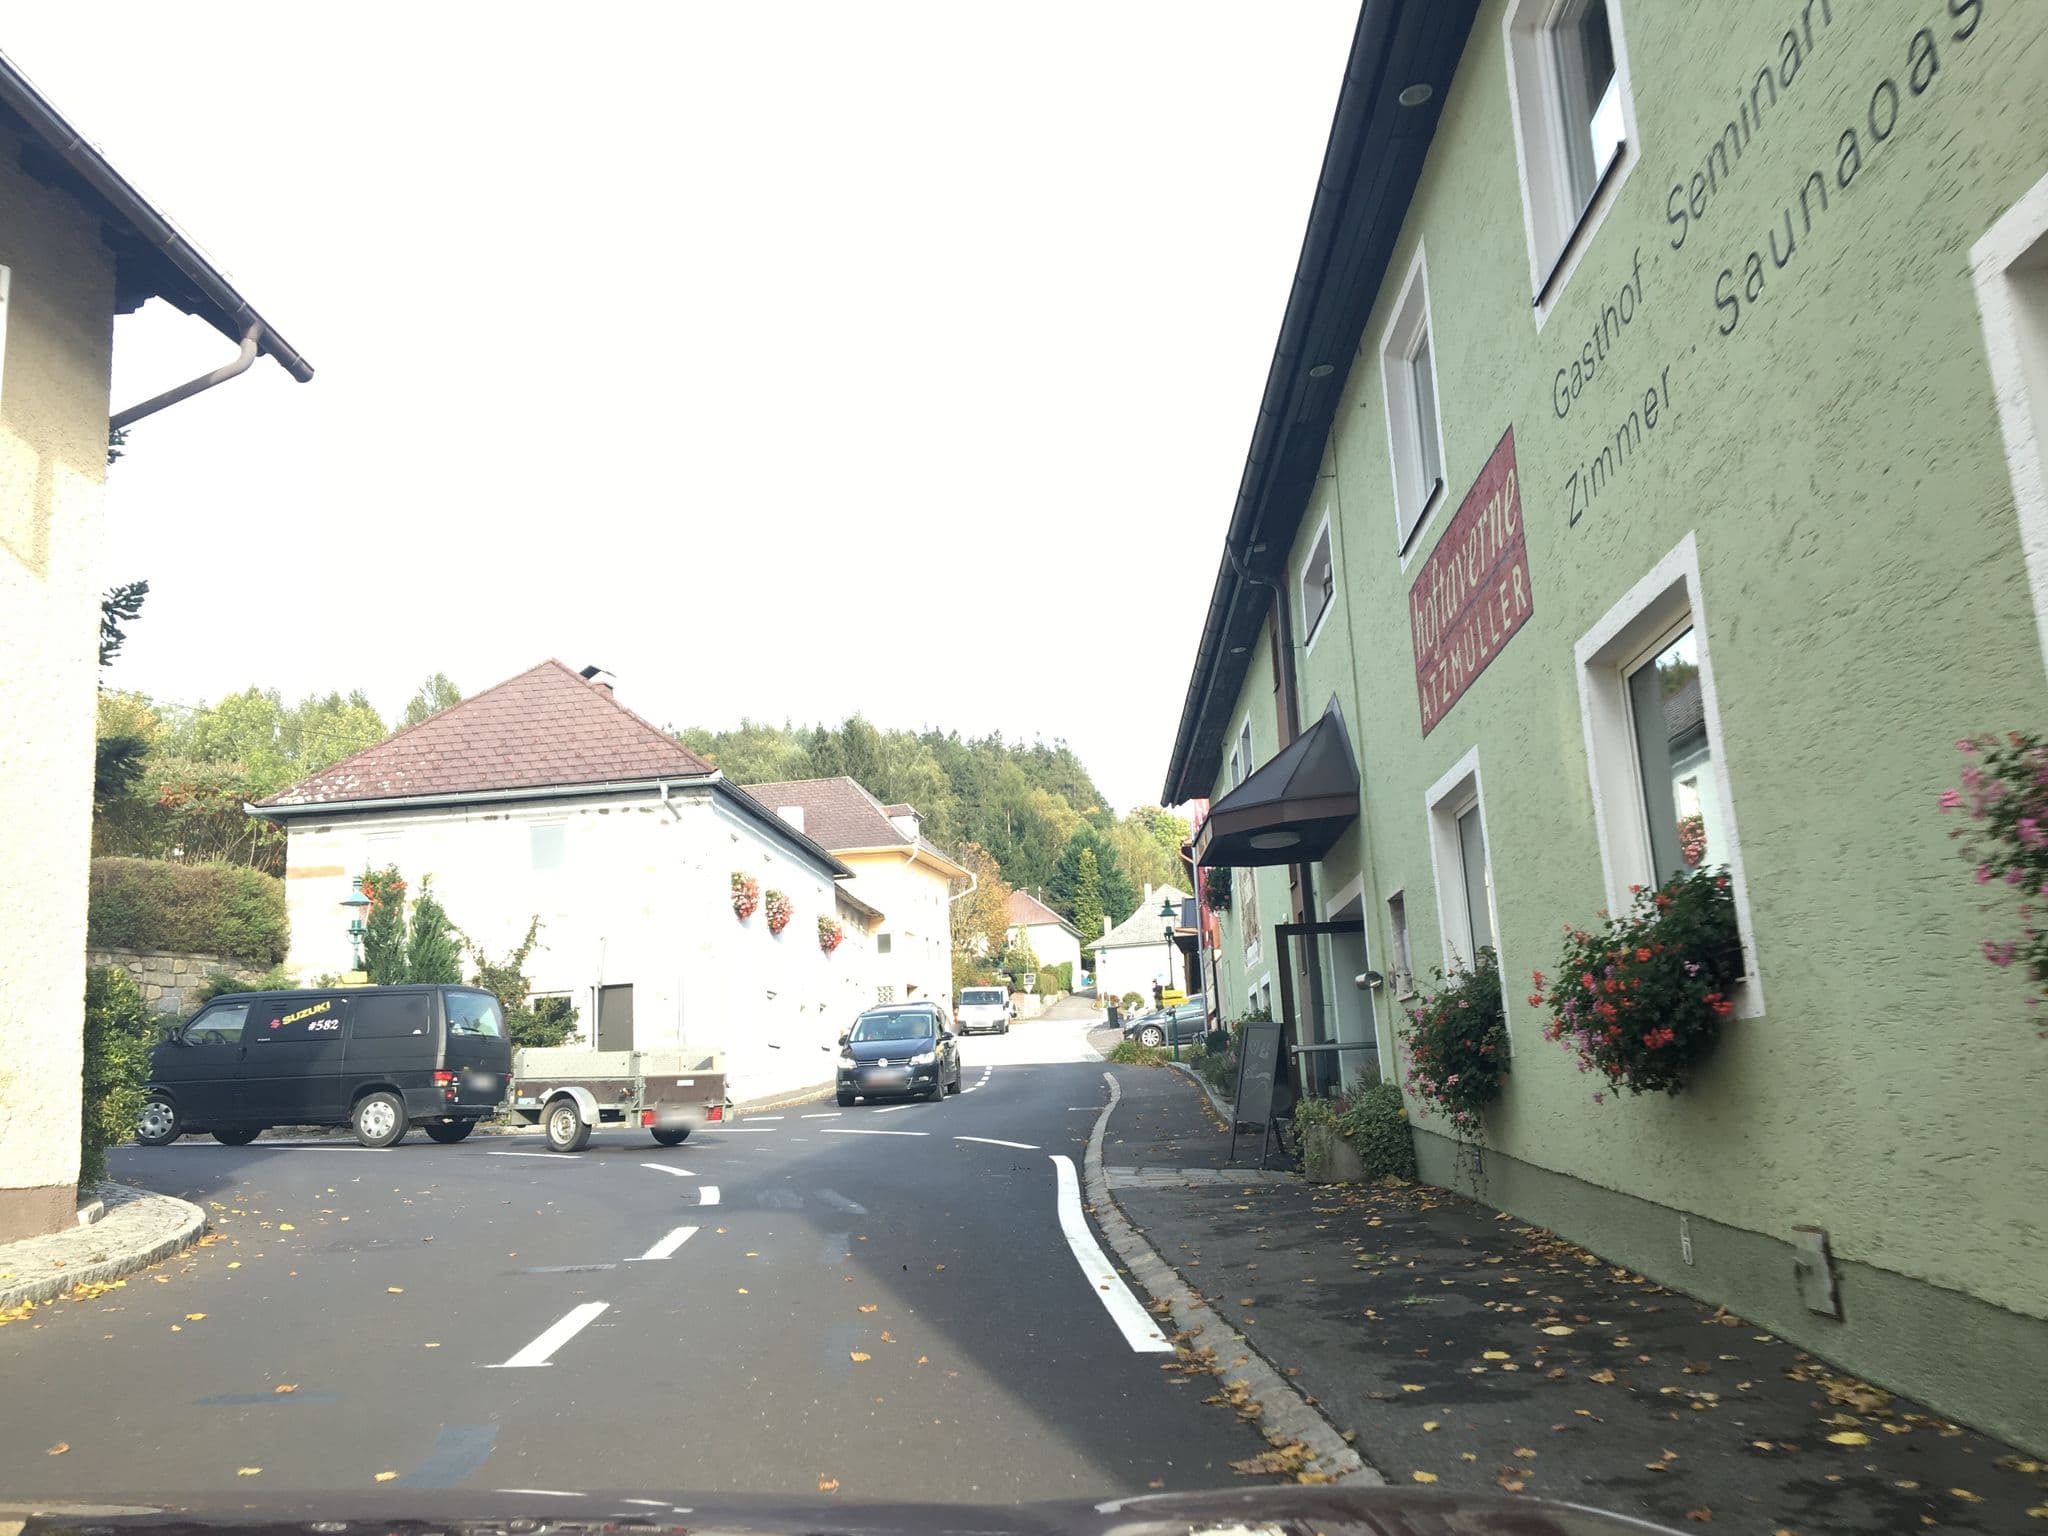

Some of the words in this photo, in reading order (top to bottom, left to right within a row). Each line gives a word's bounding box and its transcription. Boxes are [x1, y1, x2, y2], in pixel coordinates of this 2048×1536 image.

[1553, 246, 1643, 419] Gasthof
[1565, 364, 1670, 528] Zimmer
[1413, 467, 1517, 662] hoftaverne
[1421, 563, 1527, 725] ATZMÜLLER
[281, 1000, 332, 1025] SUZUKI
[307, 1019, 340, 1031] #582
